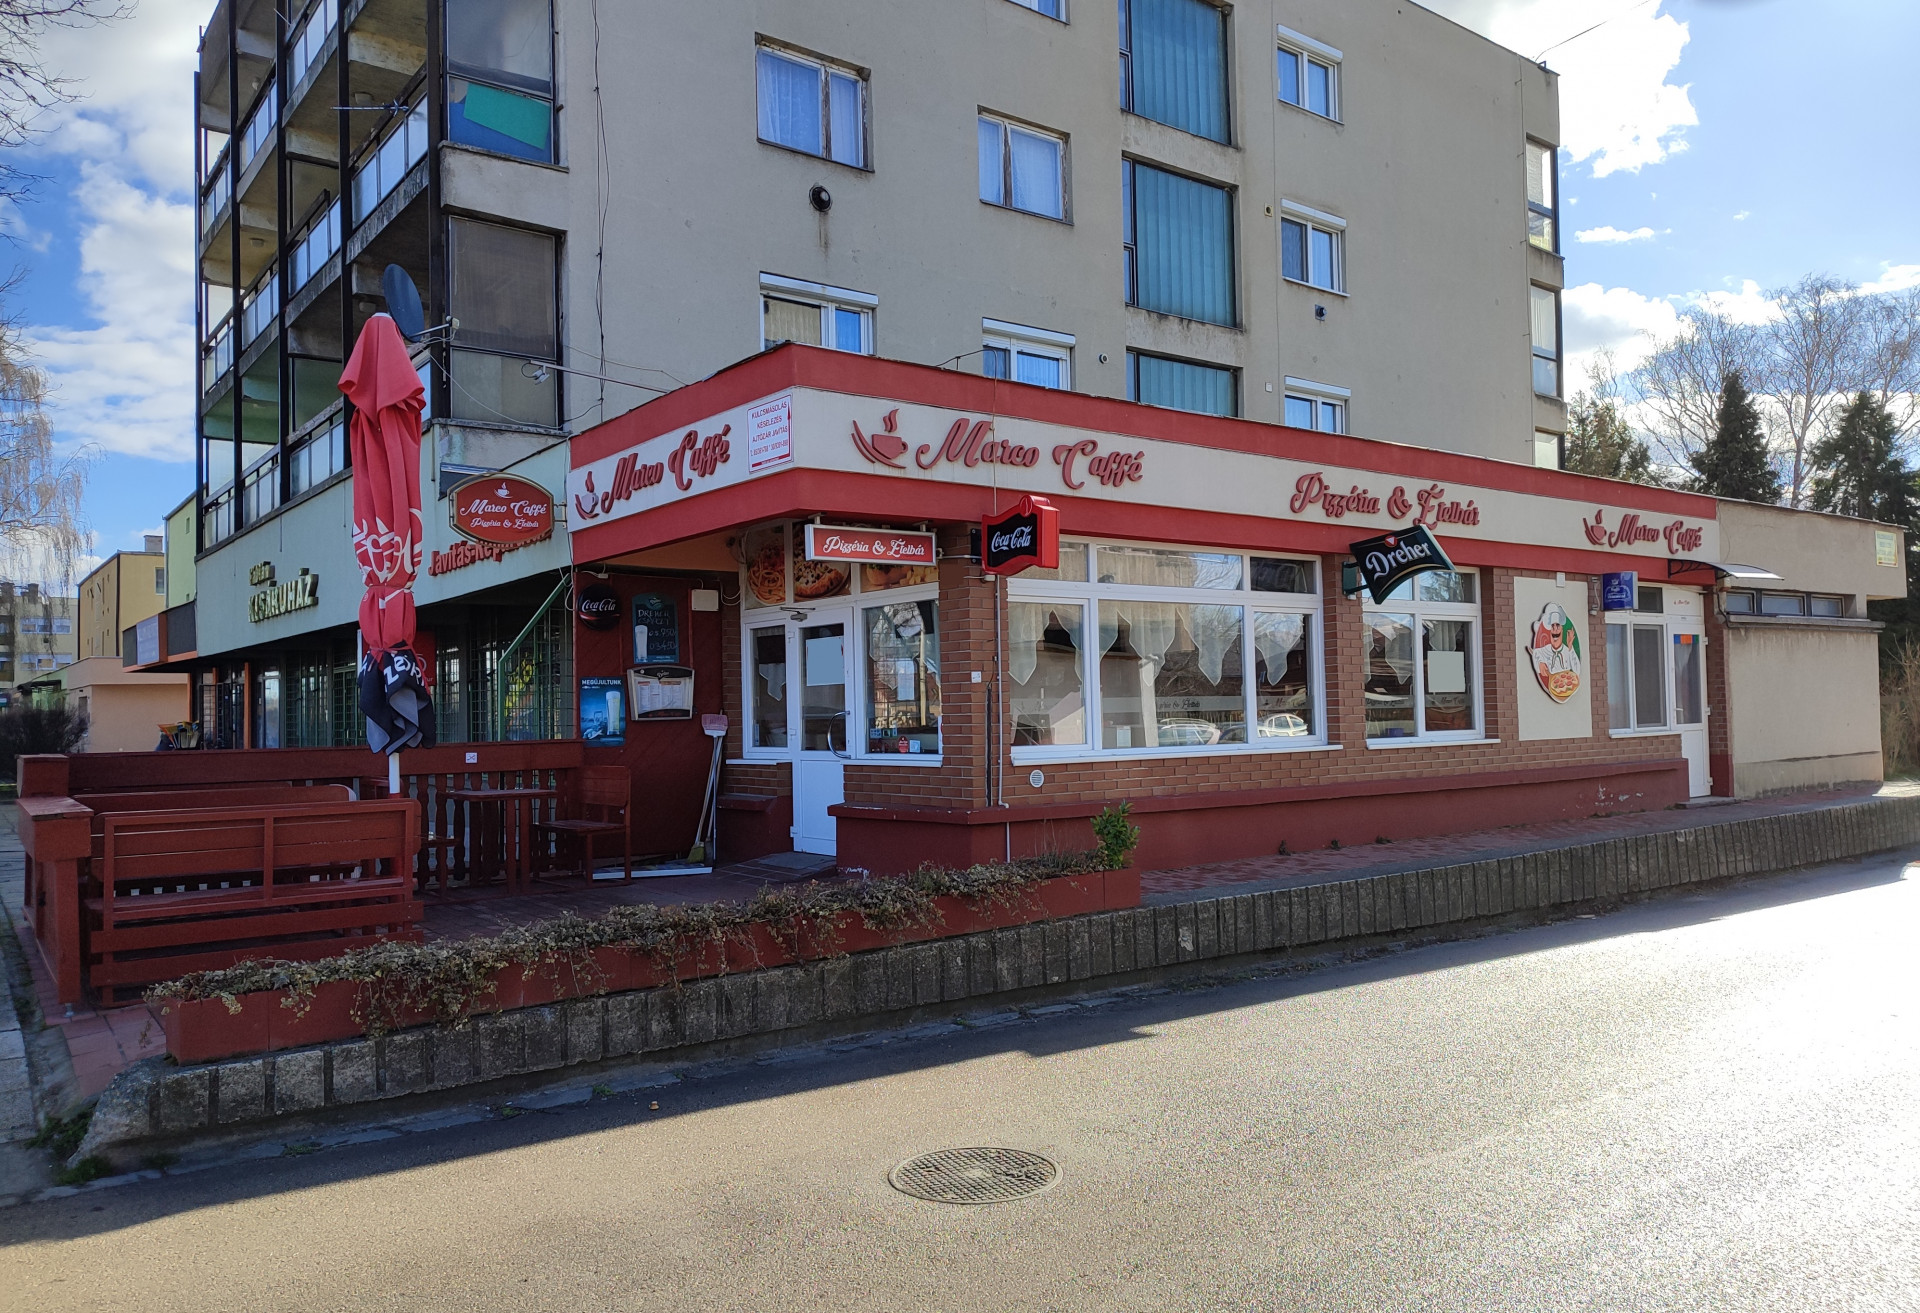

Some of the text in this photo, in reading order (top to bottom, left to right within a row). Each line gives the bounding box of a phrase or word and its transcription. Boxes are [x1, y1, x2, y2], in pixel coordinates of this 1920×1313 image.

[601, 424, 731, 514] Marco Caffé
[916, 418, 1146, 490] Marco Caffé
[460, 499, 547, 517] Marco Caffé
[1290, 472, 1480, 530] Pizzéria & Ételbár
[503, 519, 511, 528] &
[991, 526, 1033, 552] Coca-Cola
[1608, 514, 1703, 554] Marco Caffé
[823, 535, 925, 558] Pizzéria & Ételbár
[1365, 541, 1432, 581] Dreher
[581, 599, 616, 612] Coca-Cola
